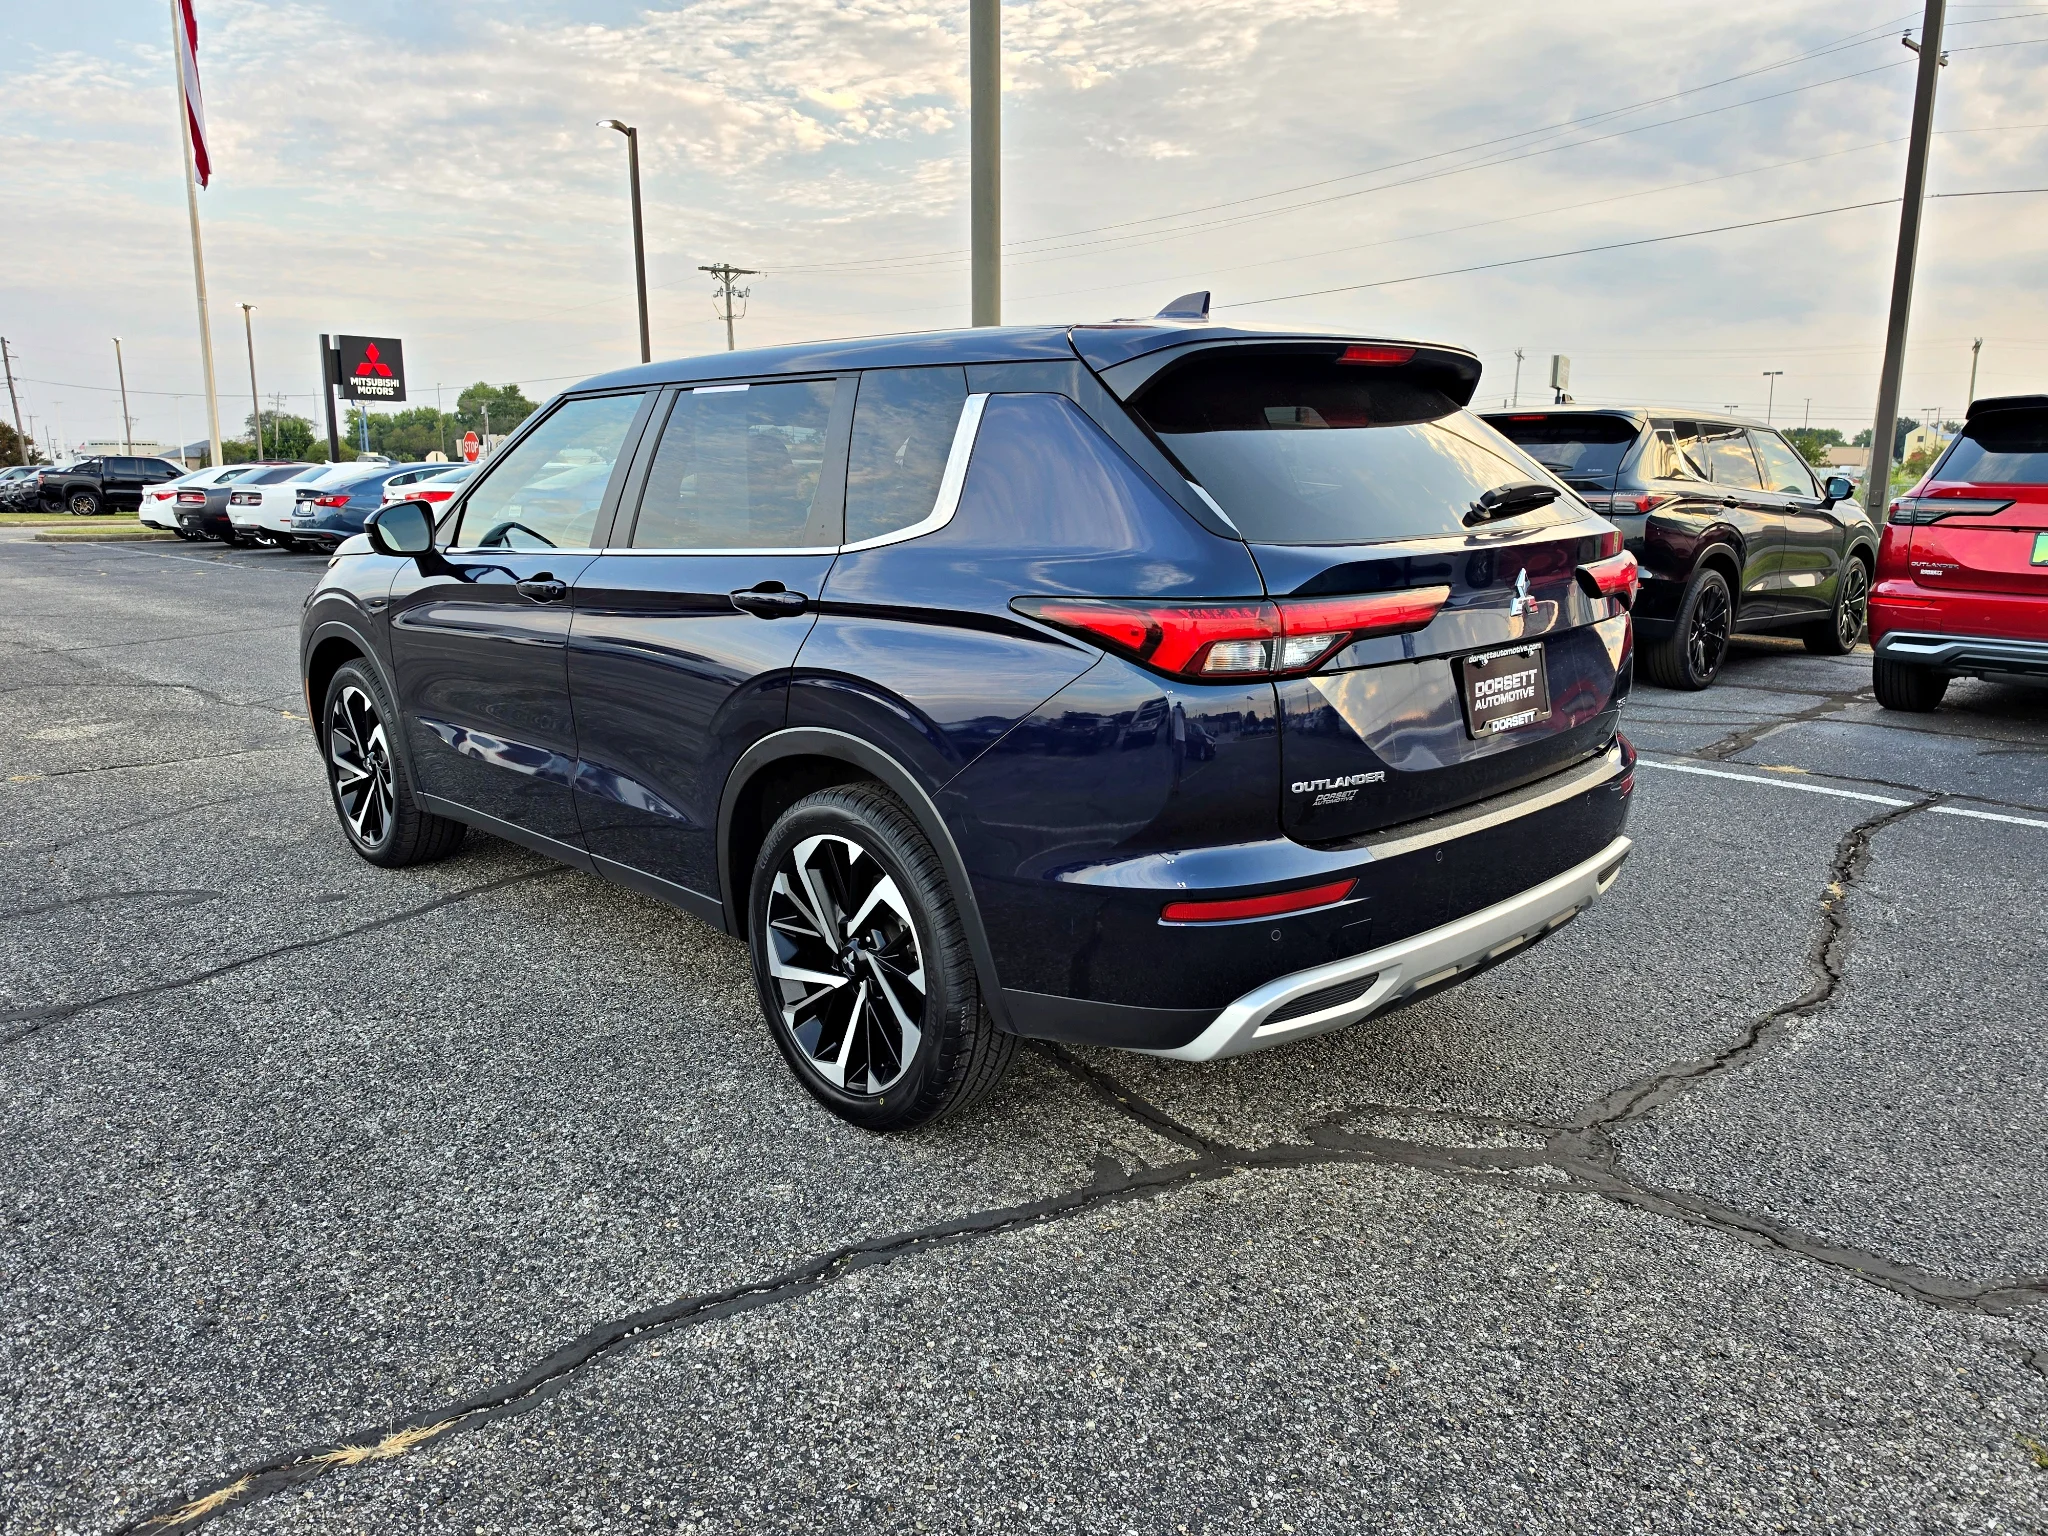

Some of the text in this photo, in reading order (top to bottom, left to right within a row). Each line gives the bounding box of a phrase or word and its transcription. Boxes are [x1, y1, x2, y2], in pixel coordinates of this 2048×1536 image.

[350, 377, 400, 387] MITSUBISHI
[357, 386, 395, 396] MOTORS
[464, 441, 479, 453] STOP
[1468, 643, 1541, 664] dorsettautomotive.com
[1474, 668, 1538, 698] DORSETT
[1474, 686, 1535, 711] AUTOMOTIVE
[1492, 711, 1536, 733] DORSETT
[1291, 770, 1387, 794] OUTLANDER
[1312, 795, 1355, 807] AUTOMOTIVE
[1315, 789, 1359, 802] DORSETT
